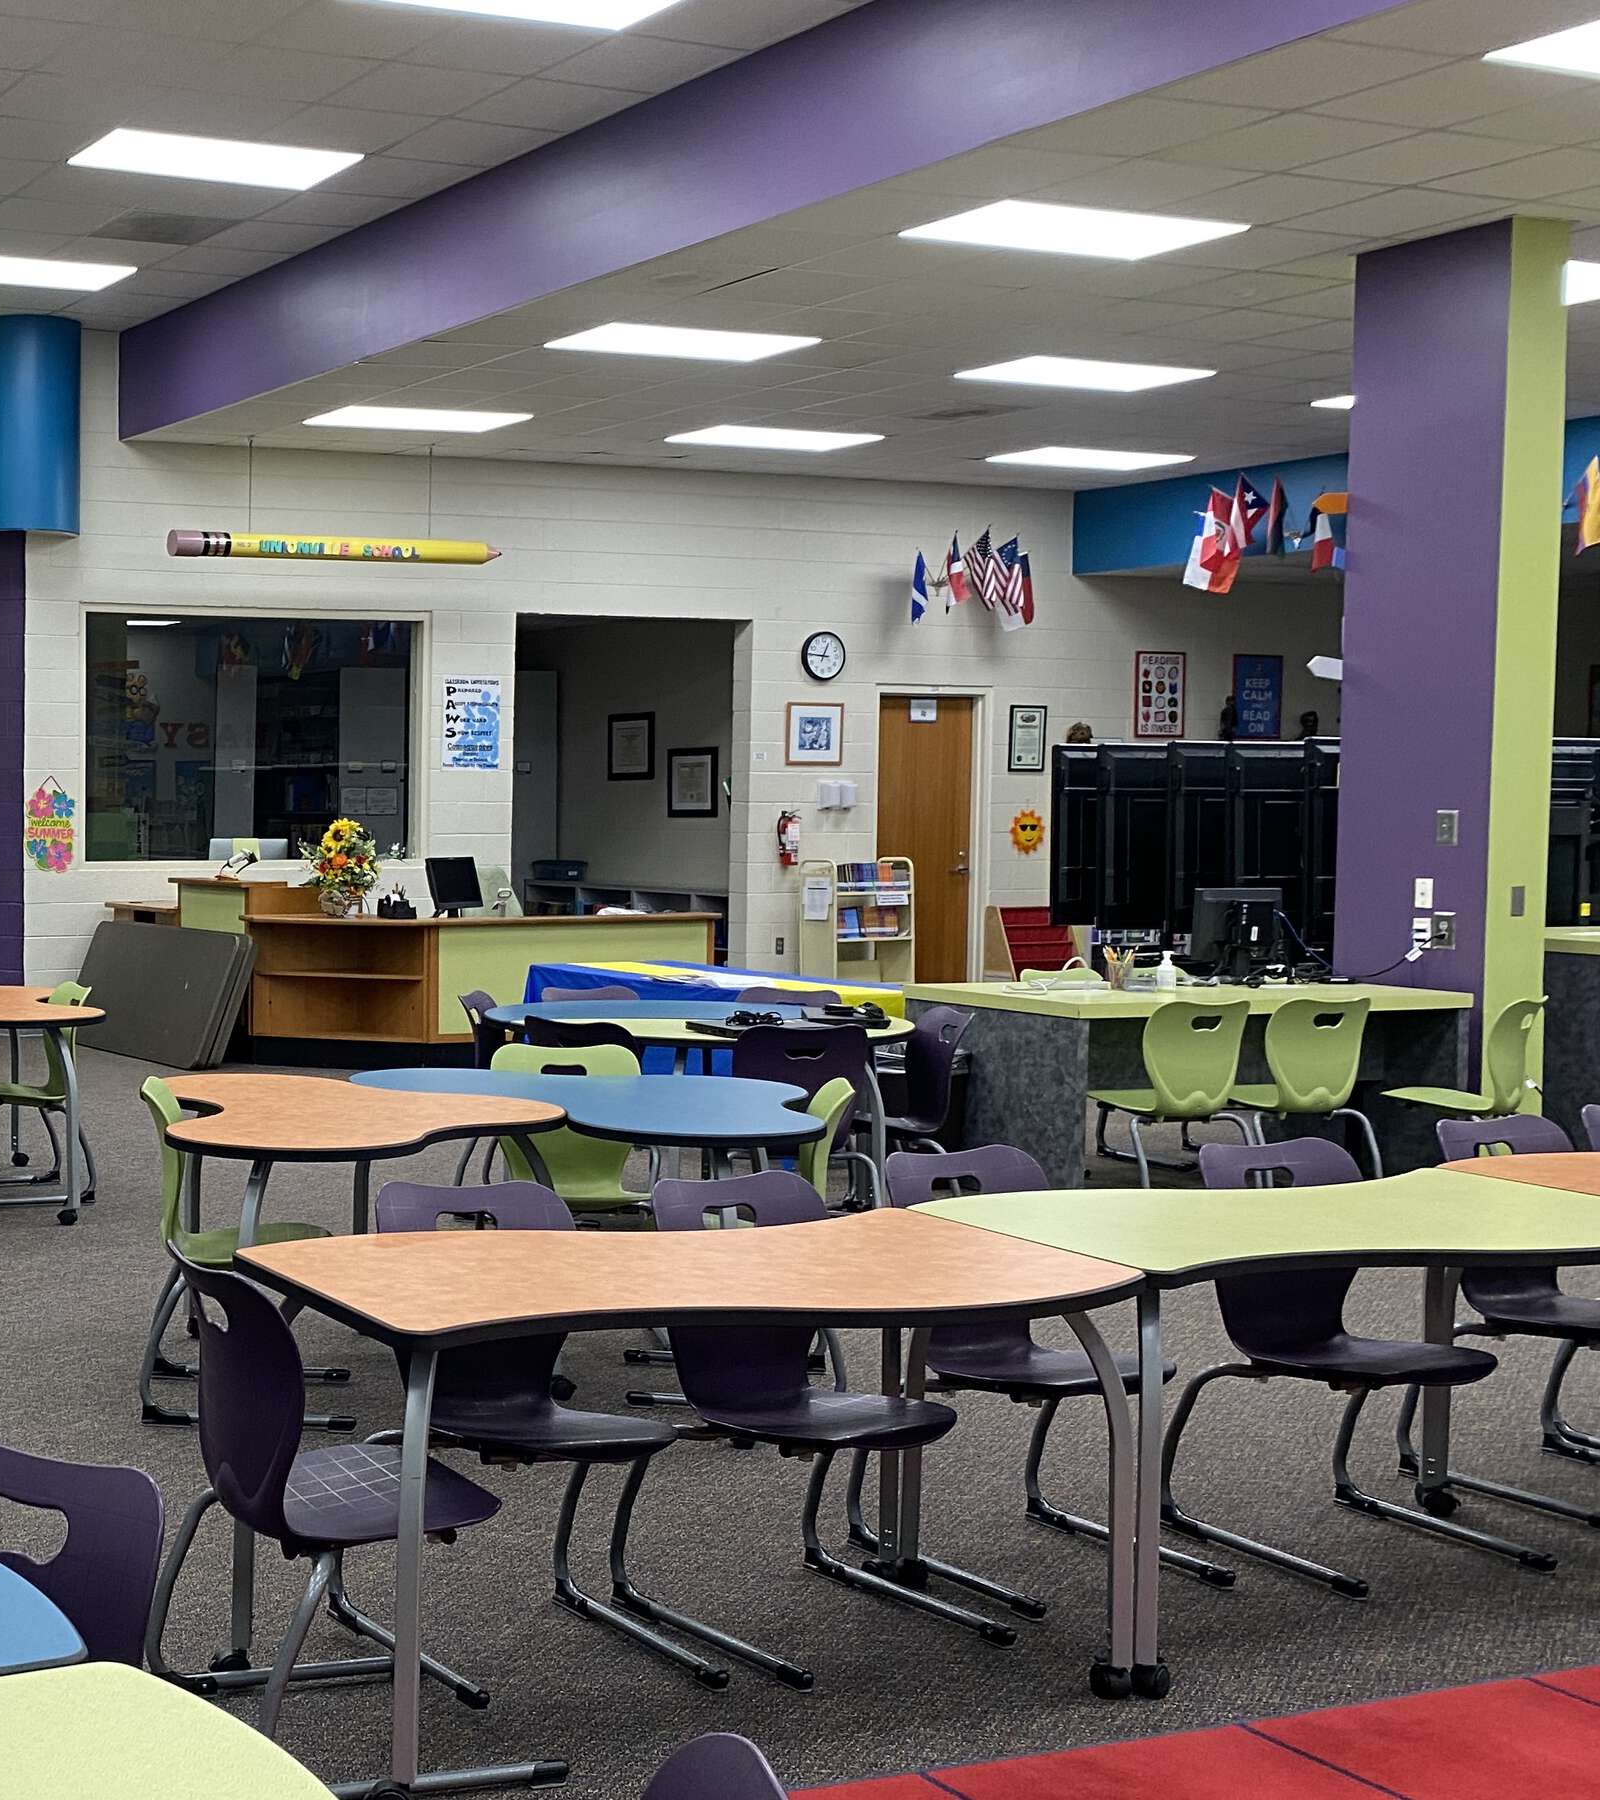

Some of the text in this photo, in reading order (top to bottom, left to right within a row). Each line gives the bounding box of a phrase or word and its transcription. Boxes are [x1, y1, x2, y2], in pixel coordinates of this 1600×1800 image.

[259, 539, 420, 560] UNIONVILLE SCHOOL
[1142, 655, 1180, 665] READING
[1244, 678, 1270, 688] KEEP
[1242, 690, 1272, 700] CALM
[1242, 710, 1270, 721] READ
[1141, 723, 1178, 733] IS SWEET
[1248, 722, 1265, 733] ON
[30, 818, 71, 828] welcome
[28, 827, 74, 839] SUMMER
